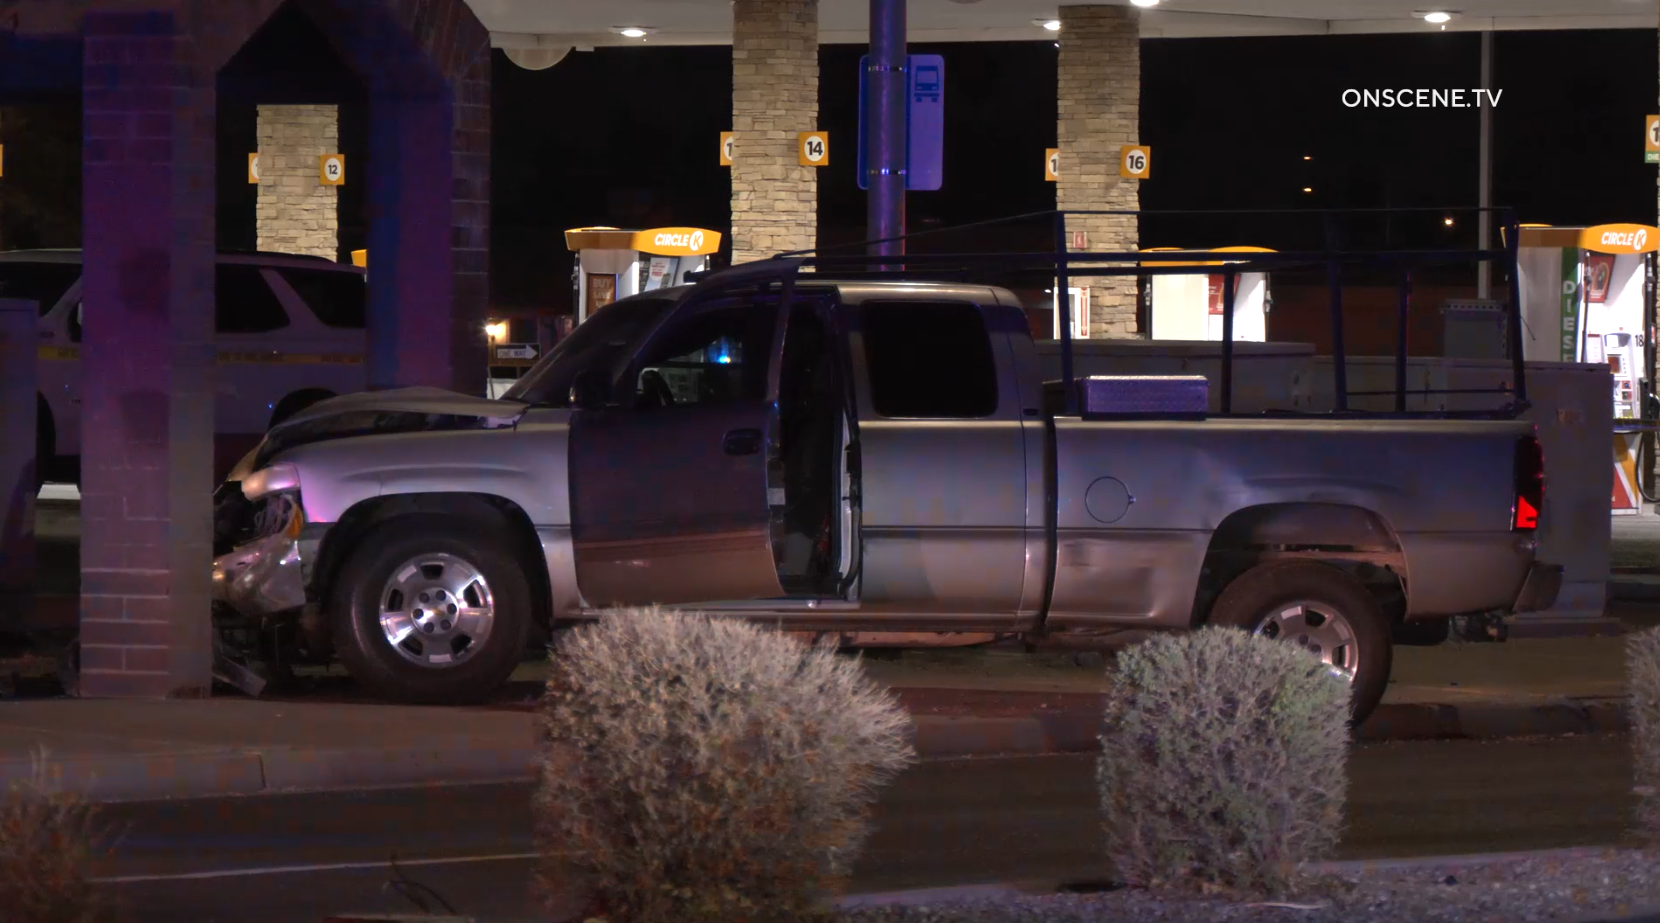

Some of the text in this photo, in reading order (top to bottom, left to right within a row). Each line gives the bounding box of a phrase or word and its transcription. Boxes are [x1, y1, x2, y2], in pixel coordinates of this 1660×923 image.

[726, 142, 732, 157] 1
[806, 140, 823, 156] 14
[327, 164, 338, 175] 12
[1051, 158, 1058, 172] 1
[1128, 155, 1145, 170] 16
[654, 231, 703, 251] CIRCLE K
[1601, 229, 1647, 250] CIRCLE K
[592, 278, 612, 288] BUY
[1563, 280, 1576, 363] DIESE
[1635, 334, 1644, 347] 18
